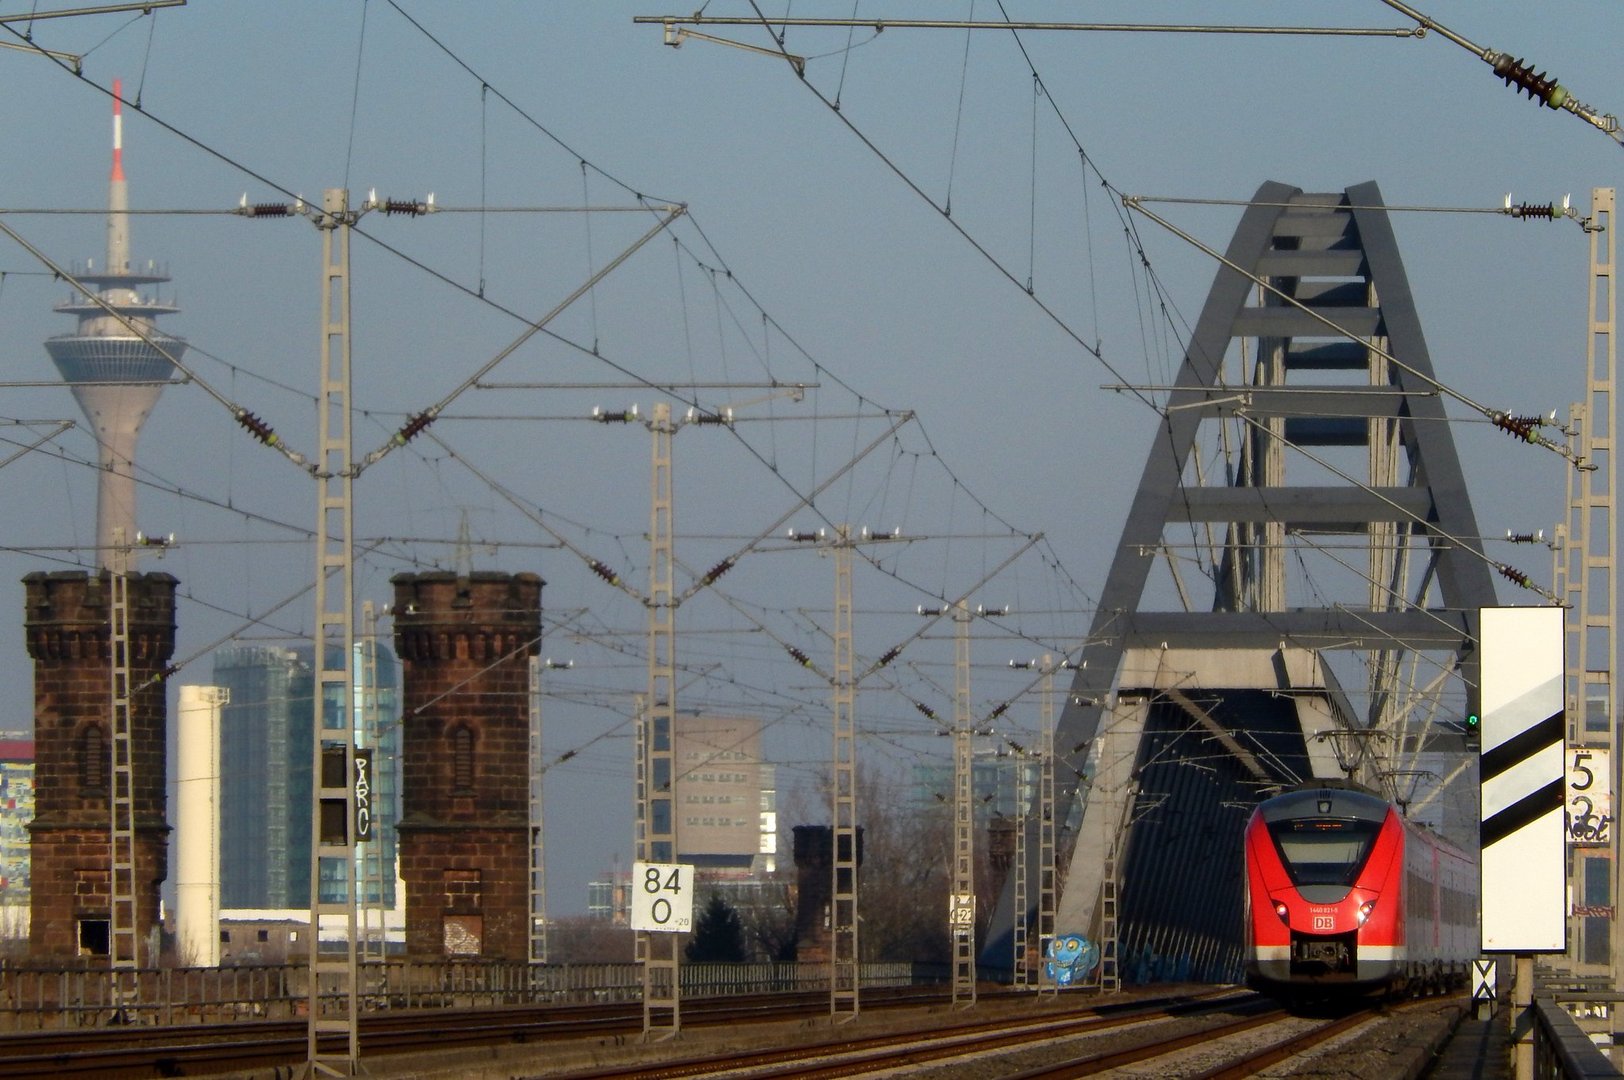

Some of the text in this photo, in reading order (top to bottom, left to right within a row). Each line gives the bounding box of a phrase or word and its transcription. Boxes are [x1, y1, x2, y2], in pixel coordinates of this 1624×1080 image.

[1570, 753, 1594, 791] 5
[355, 758, 369, 835] PARC
[644, 867, 681, 895] 84
[651, 898, 672, 924] 0
[1315, 917, 1333, 929] DB
